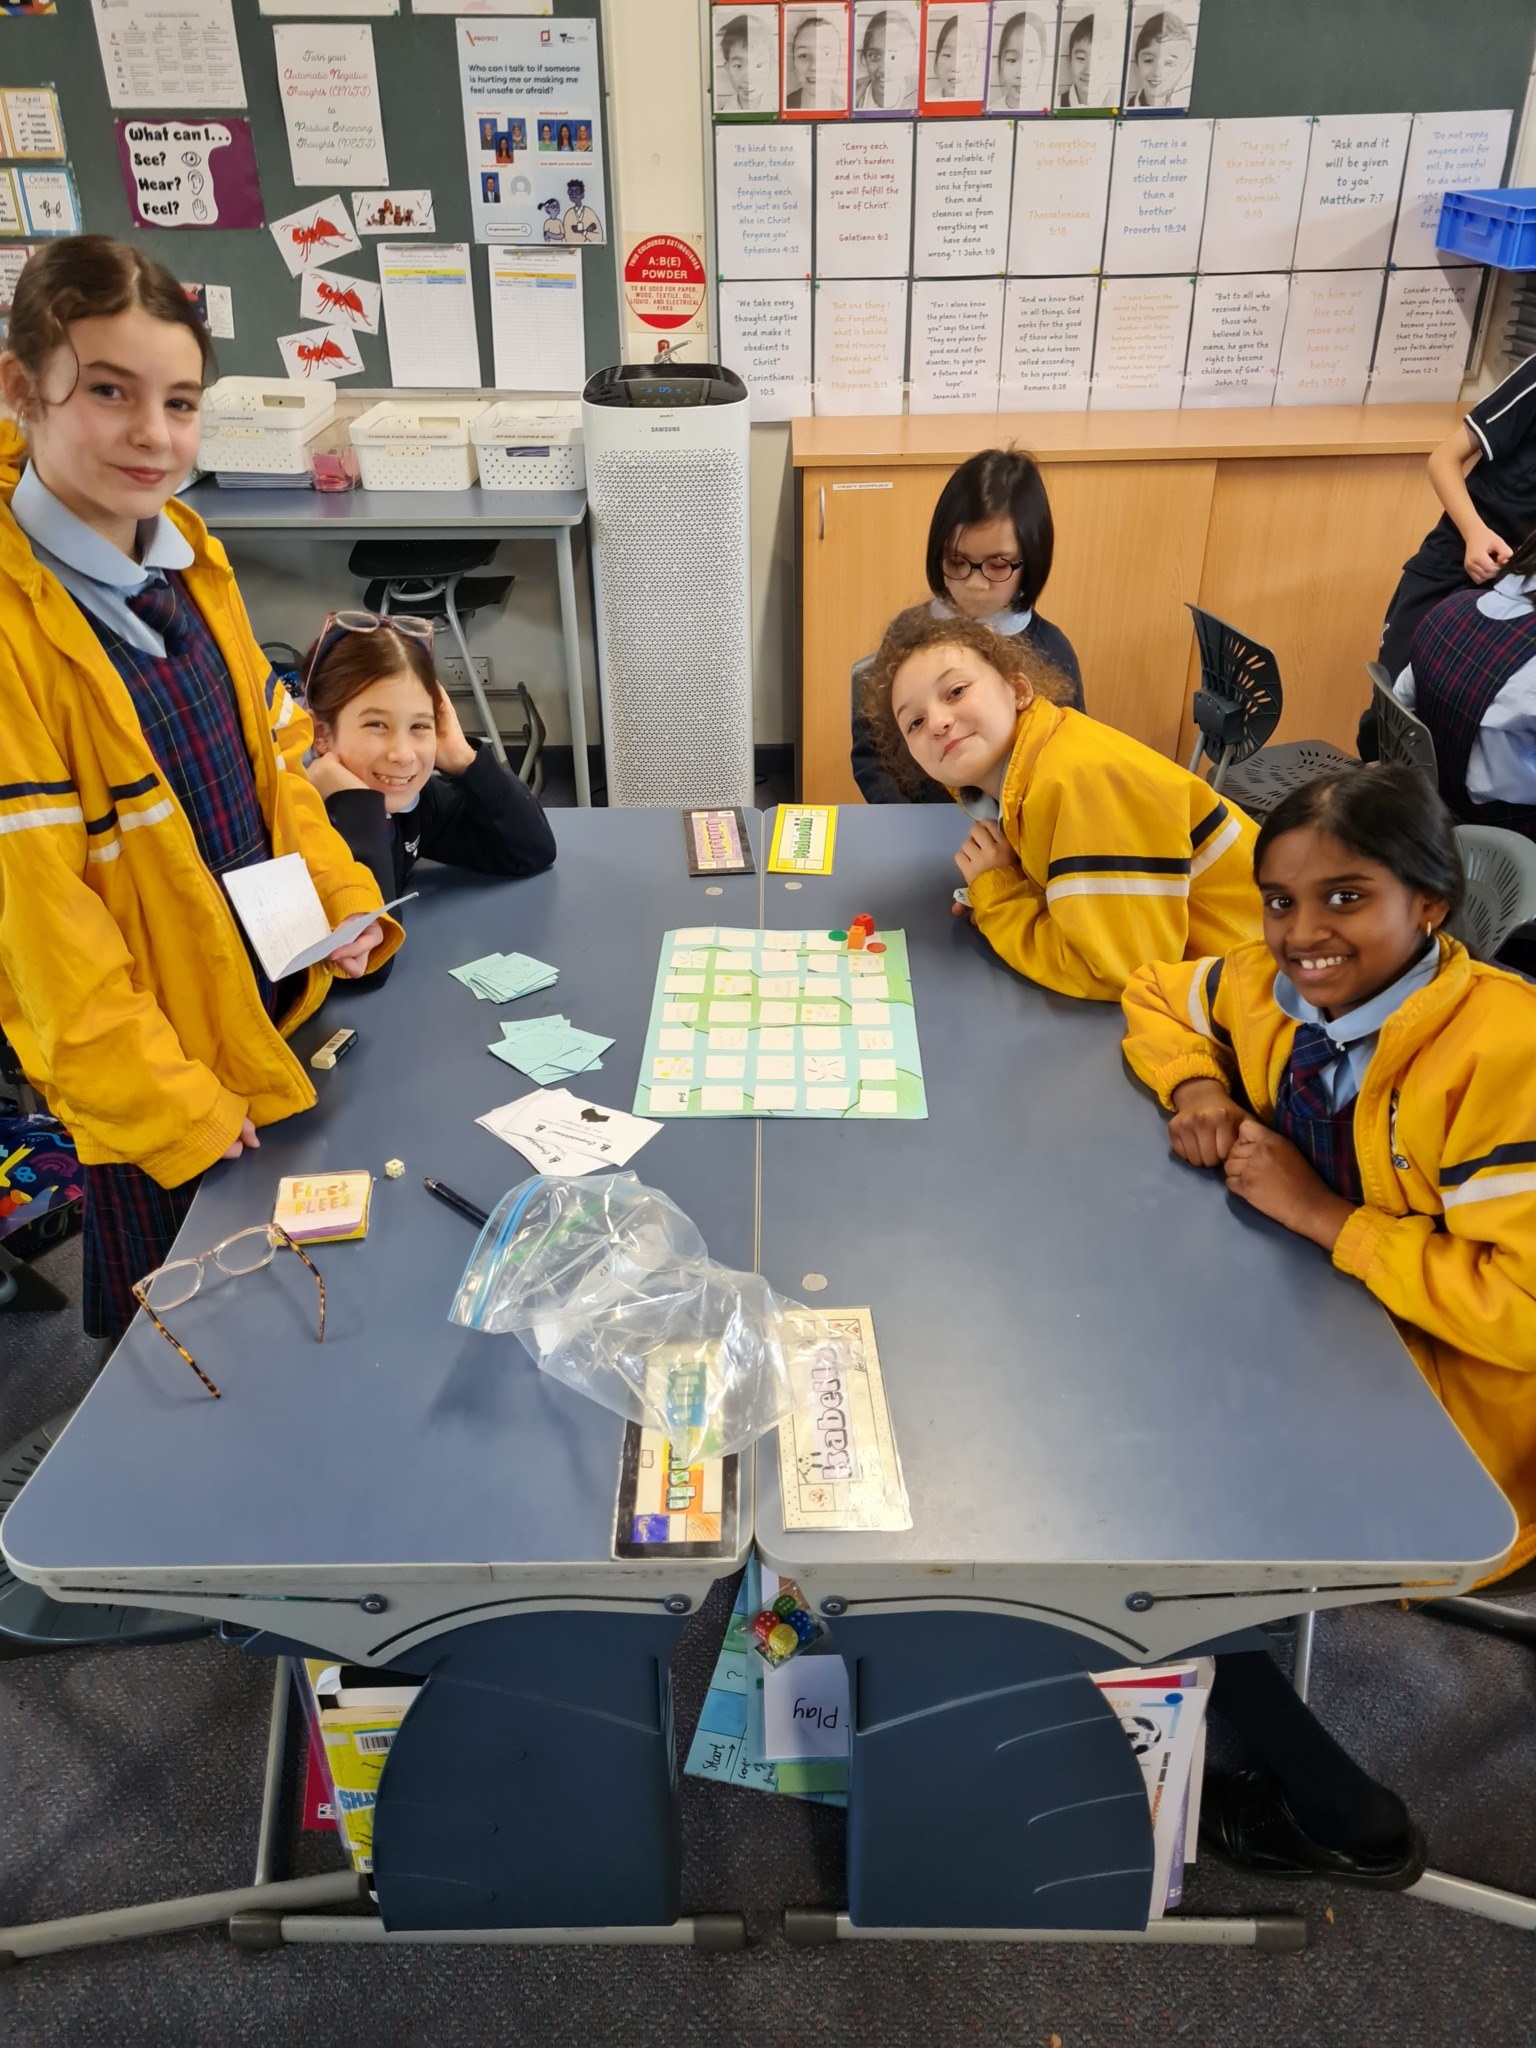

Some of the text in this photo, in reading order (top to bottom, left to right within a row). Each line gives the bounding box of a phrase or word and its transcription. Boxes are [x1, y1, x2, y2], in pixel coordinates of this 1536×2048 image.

[303, 50, 347, 64] Turn your
[468, 64, 486, 72] Who
[505, 64, 507, 72] I
[509, 64, 525, 72] talk
[537, 64, 542, 72] if
[284, 68, 368, 83] Automatic Negative
[478, 76, 507, 85] hurting
[534, 76, 564, 85] making
[287, 86, 326, 99] Thoughts
[526, 86, 554, 94] afraid?
[328, 106, 336, 115] to
[295, 121, 373, 134] Positive Enhancing
[128, 126, 169, 142] What
[173, 129, 201, 142] can
[296, 138, 335, 151] Thoughts
[870, 142, 888, 150] each
[1172, 139, 1178, 147] is
[1356, 138, 1378, 148] and
[1382, 138, 1390, 148] it
[134, 152, 167, 167] See?
[326, 155, 351, 166] today!
[836, 156, 894, 166] other's burdens
[1138, 155, 1187, 168] friend who
[1326, 156, 1388, 172] will be given
[863, 172, 877, 180] this
[880, 174, 894, 183] way
[1133, 172, 1187, 183] sticks closer
[1337, 177, 1347, 186] to
[138, 177, 182, 191] Hear?
[831, 186, 898, 199] you will fulfill the
[1143, 190, 1165, 199] than
[1320, 194, 1384, 205] Matthew 7:7
[143, 202, 180, 217] Feel?
[853, 201, 861, 211] of
[1124, 224, 1186, 234] Proverbs 18:24
[629, 239, 701, 271] THIS COLOURED EXTINGUISHER
[648, 256, 681, 268] A:B(E)
[642, 270, 688, 279] POWDER
[753, 298, 771, 307] take
[774, 301, 794, 309] every
[1212, 305, 1241, 313] received
[734, 313, 797, 325] thought captive
[1221, 316, 1257, 325] those who
[761, 328, 781, 336] make
[785, 328, 791, 336] it
[1213, 330, 1240, 338] believed
[744, 343, 778, 351] obedient
[1239, 344, 1254, 352] gave
[1206, 355, 1224, 365] right
[1235, 366, 1244, 375] of
[748, 373, 794, 381] Corinthians
[1215, 379, 1248, 388] John 1:12
[760, 387, 775, 395] 10:5
[793, 1698, 839, 1729] Play
[702, 1743, 725, 1771] Start
